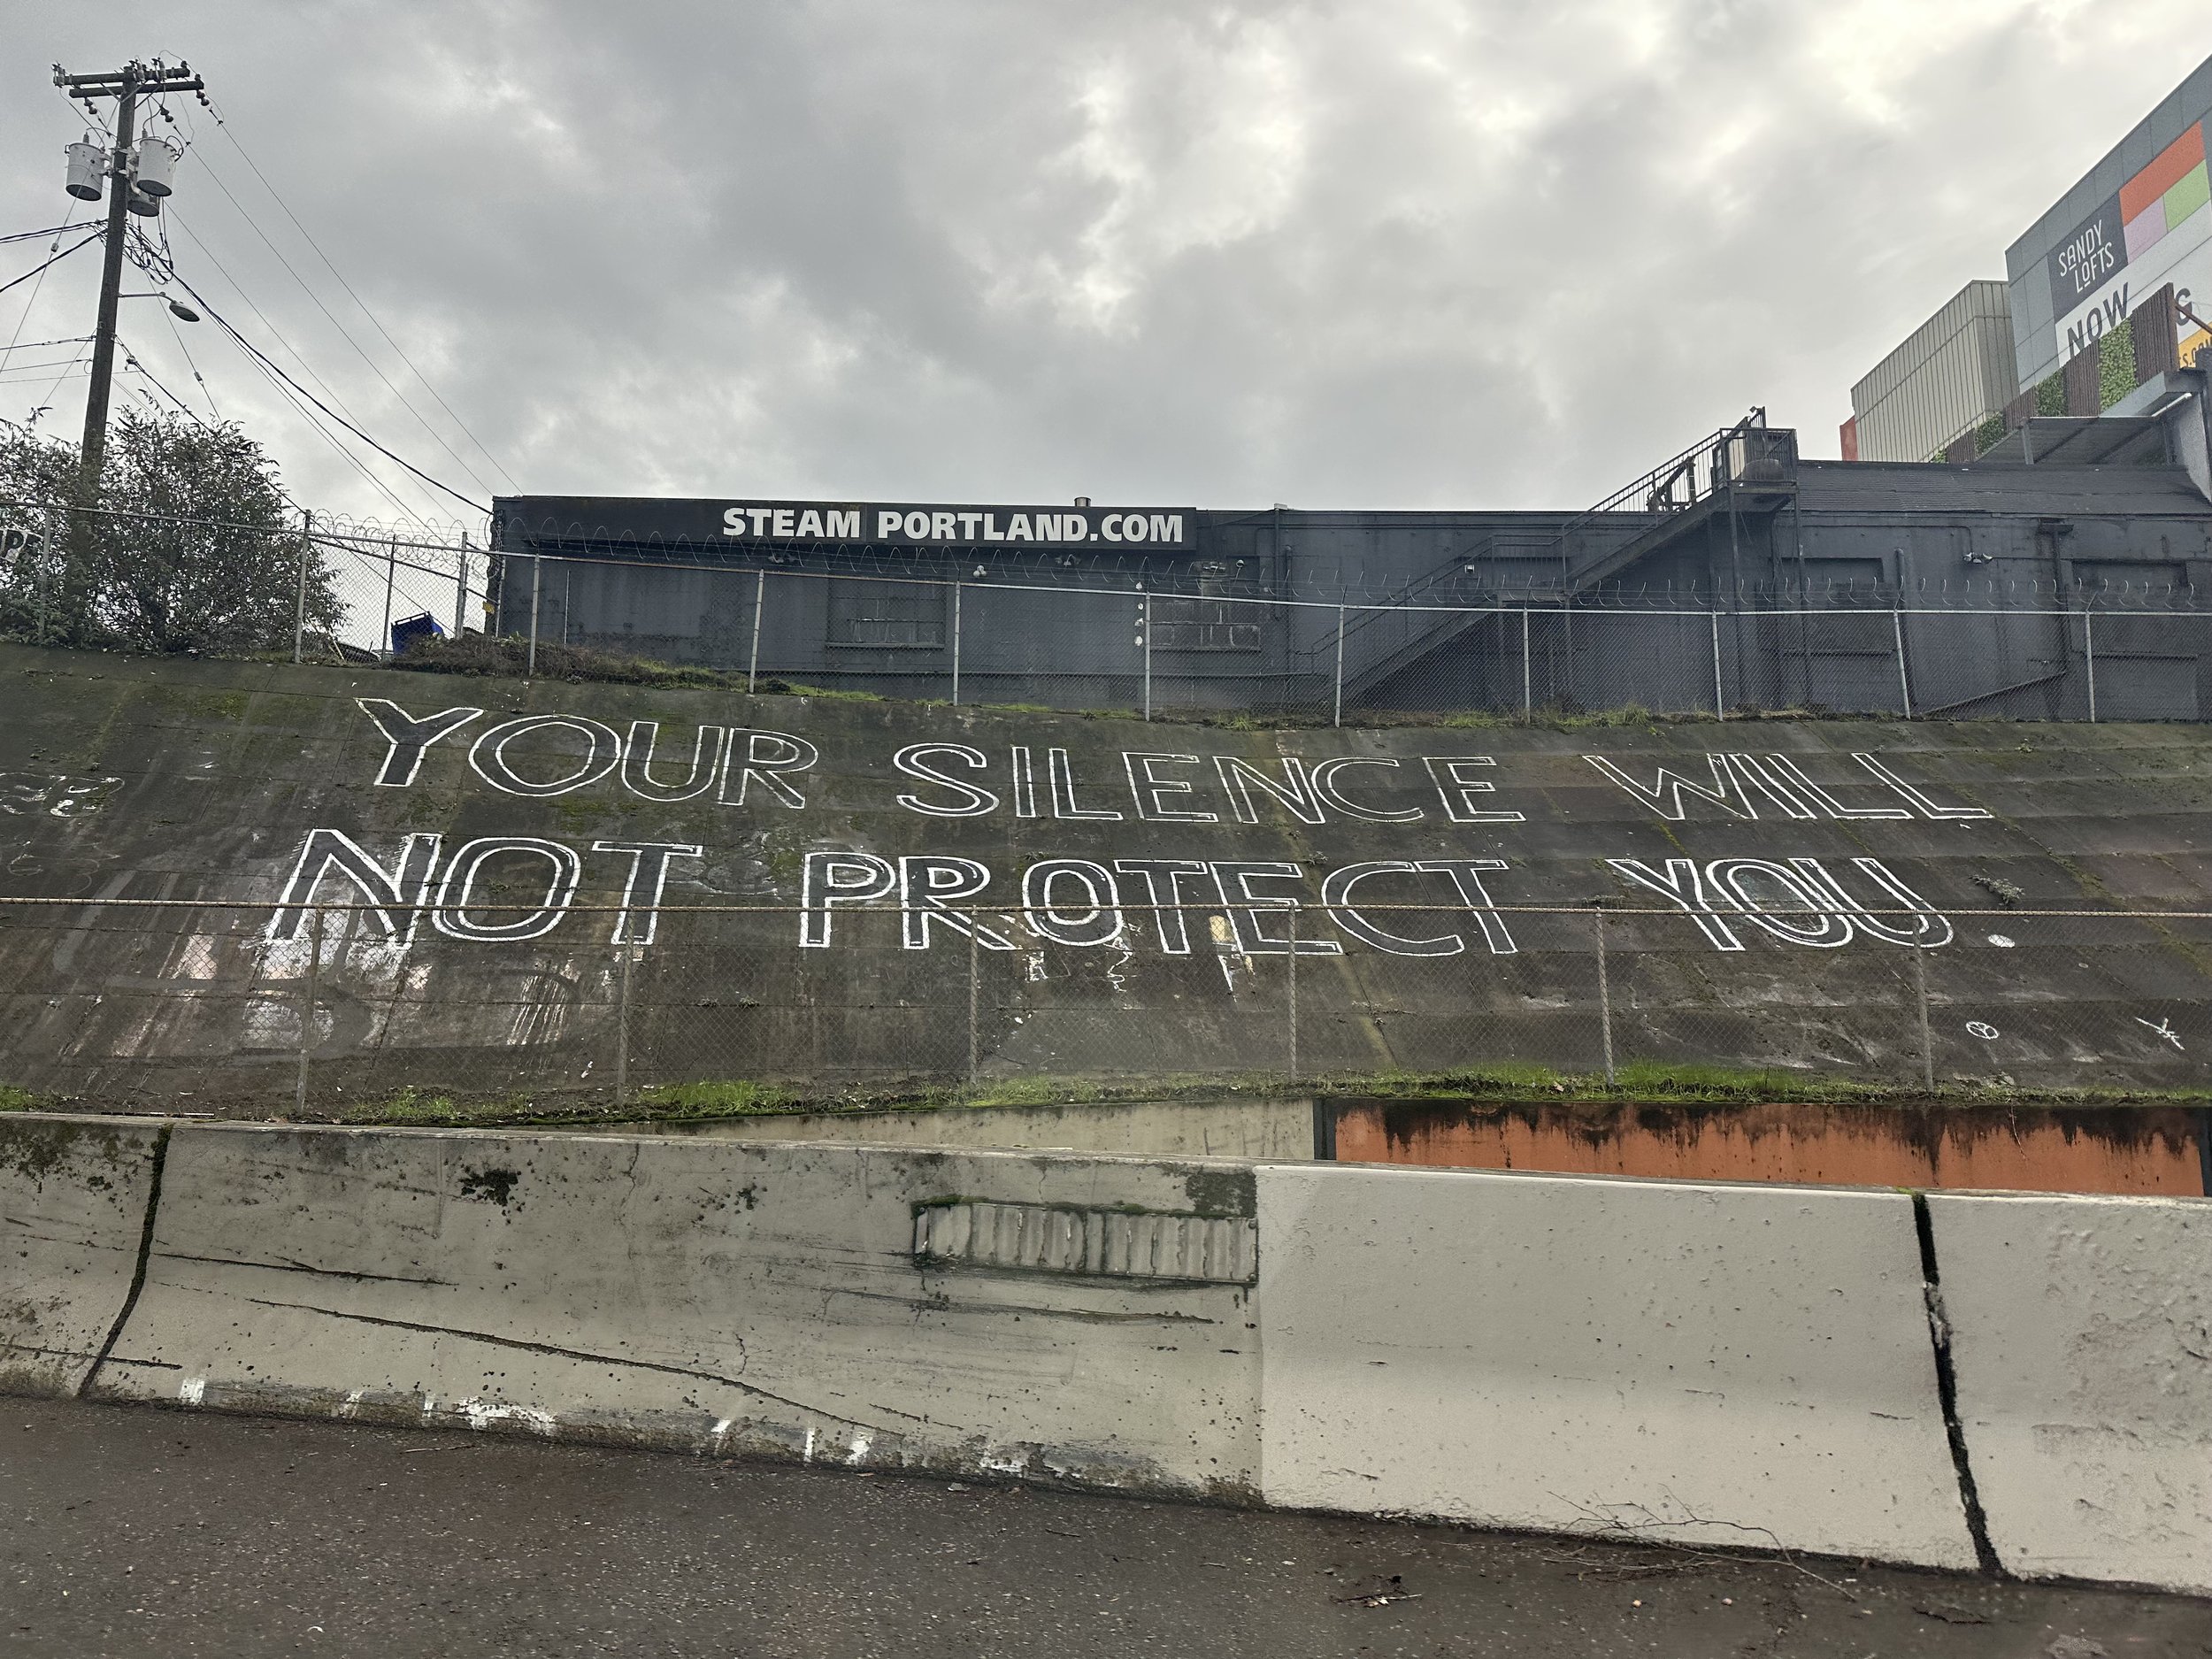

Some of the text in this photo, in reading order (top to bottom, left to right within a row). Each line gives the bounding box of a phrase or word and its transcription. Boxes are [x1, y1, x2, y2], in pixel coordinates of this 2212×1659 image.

[2058, 219, 2103, 277] SANDY
[2074, 242, 2115, 294] LOFTS
[2067, 281, 2130, 357] NOW
[722, 507, 1183, 542] STEAM PORTLAND.COM
[355, 697, 1994, 824] YOUR SILENCE WILL
[263, 828, 703, 950] NOT
[799, 851, 1518, 956] PROTECT
